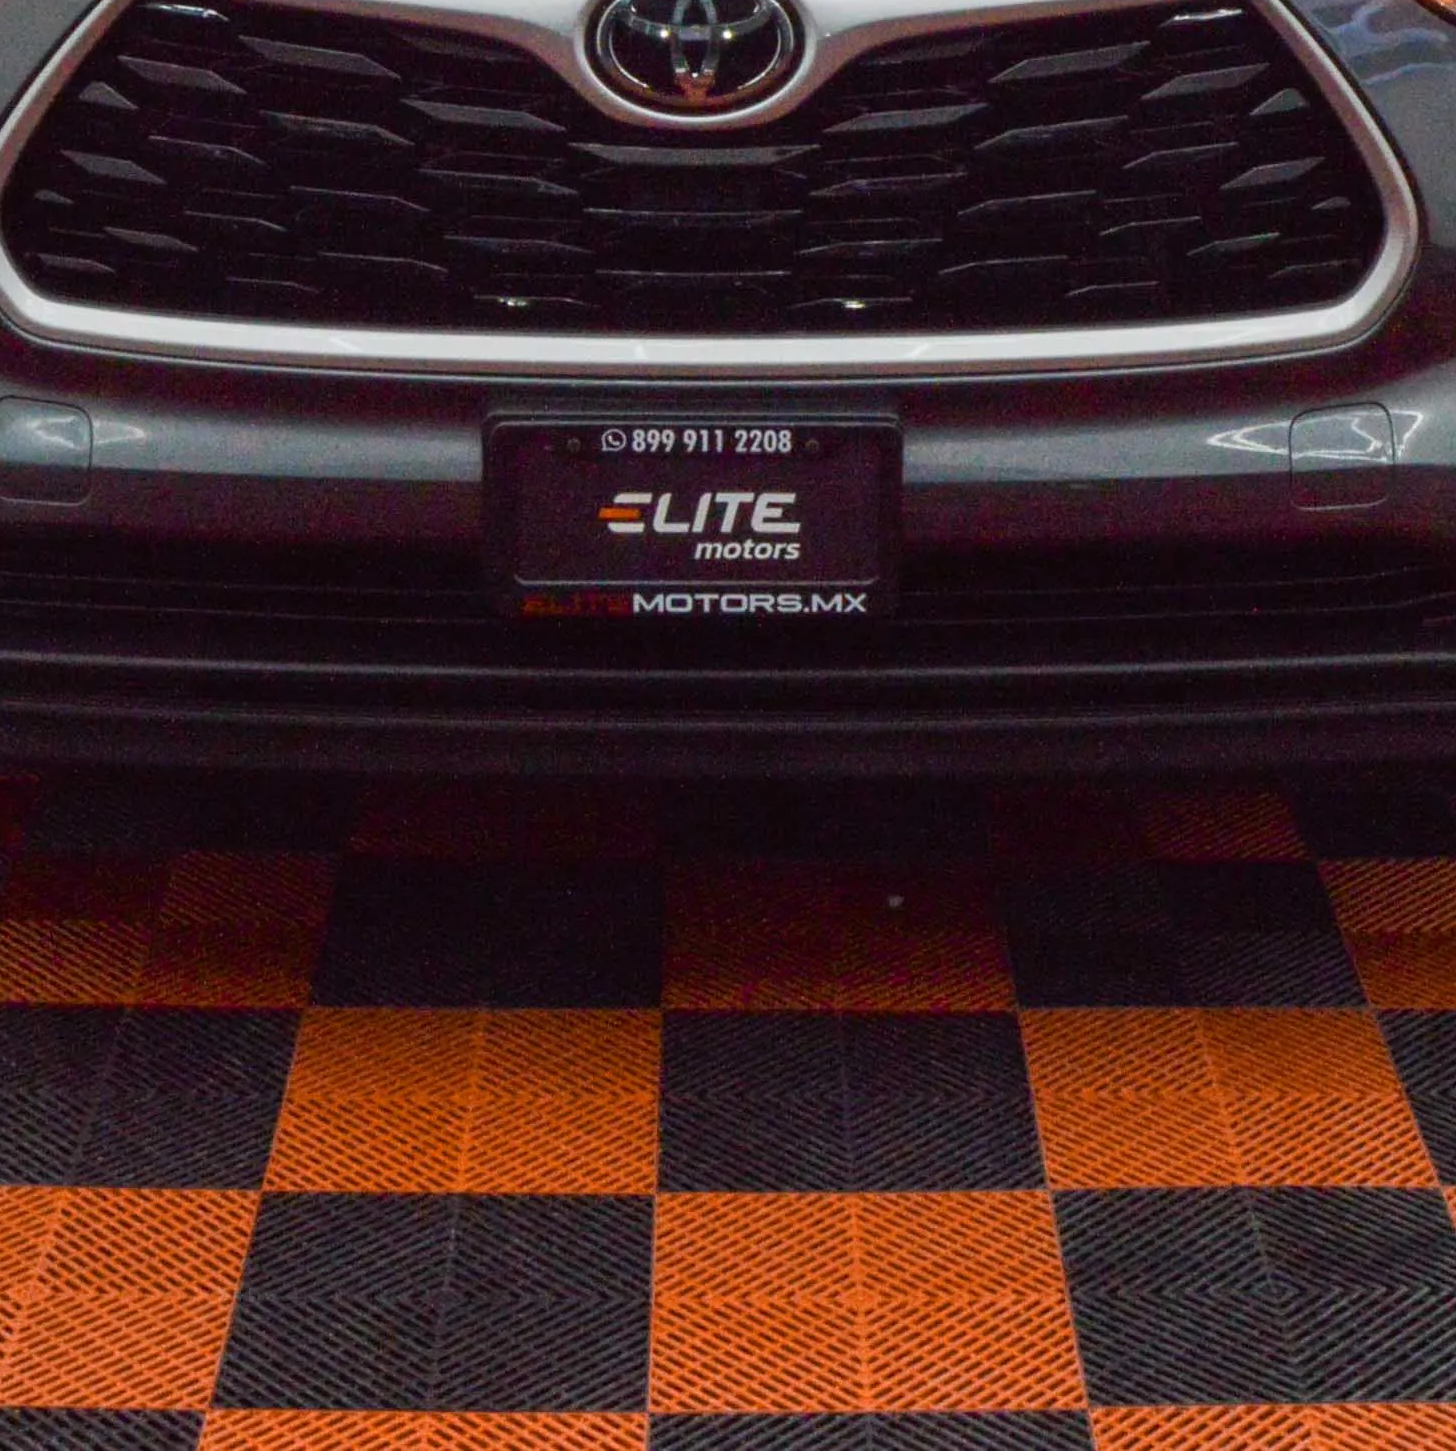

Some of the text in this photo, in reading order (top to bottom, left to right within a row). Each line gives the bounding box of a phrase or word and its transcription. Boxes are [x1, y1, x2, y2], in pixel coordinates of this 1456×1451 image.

[632, 428, 793, 453] 899 911 2208
[597, 492, 802, 534] ELITE
[693, 538, 801, 560] motors
